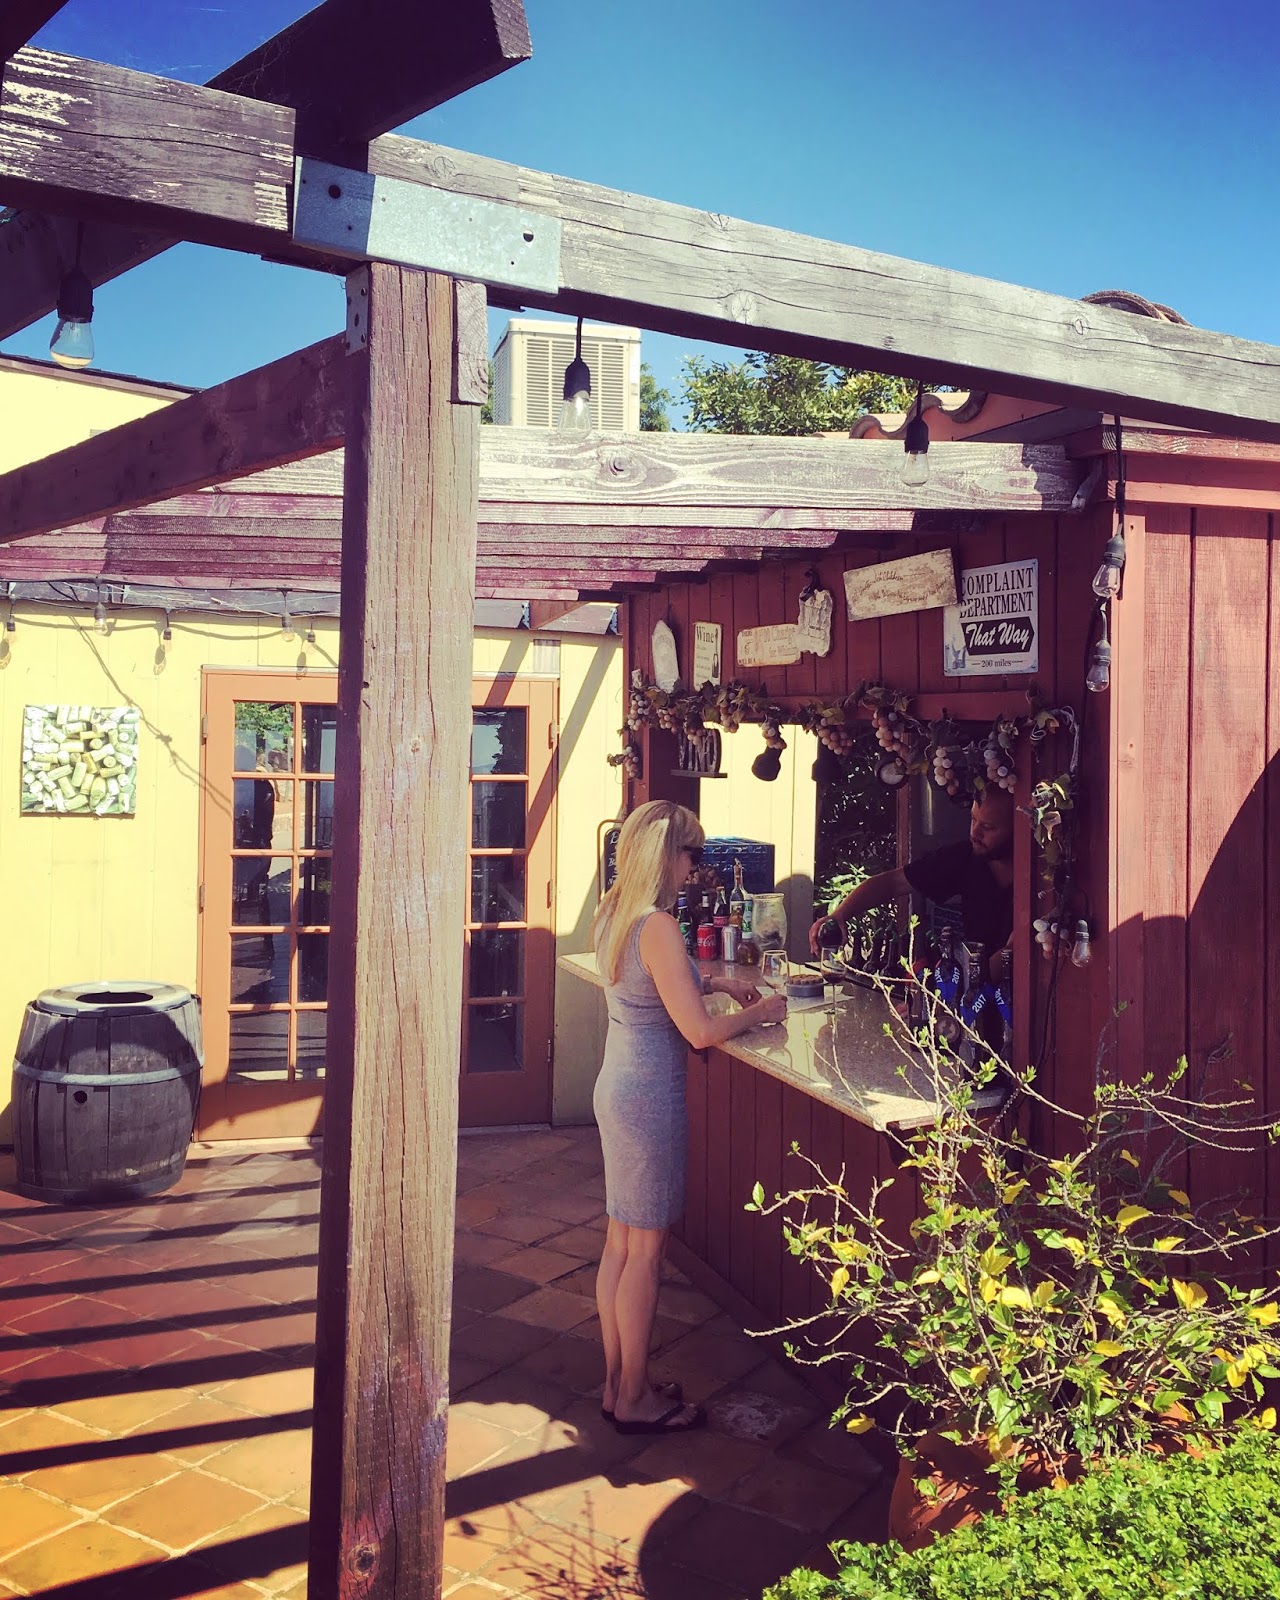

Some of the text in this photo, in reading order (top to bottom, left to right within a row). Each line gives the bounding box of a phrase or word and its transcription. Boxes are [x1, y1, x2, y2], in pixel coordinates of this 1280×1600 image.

[961, 567, 1034, 597] COMPLAINT
[960, 591, 1034, 619] DEPARTMENT
[696, 625, 714, 643] Wine
[965, 621, 1030, 650] That Way
[981, 658, 1012, 668] 200 miles
[952, 967, 960, 984] 2017
[972, 994, 986, 1013] 2017
